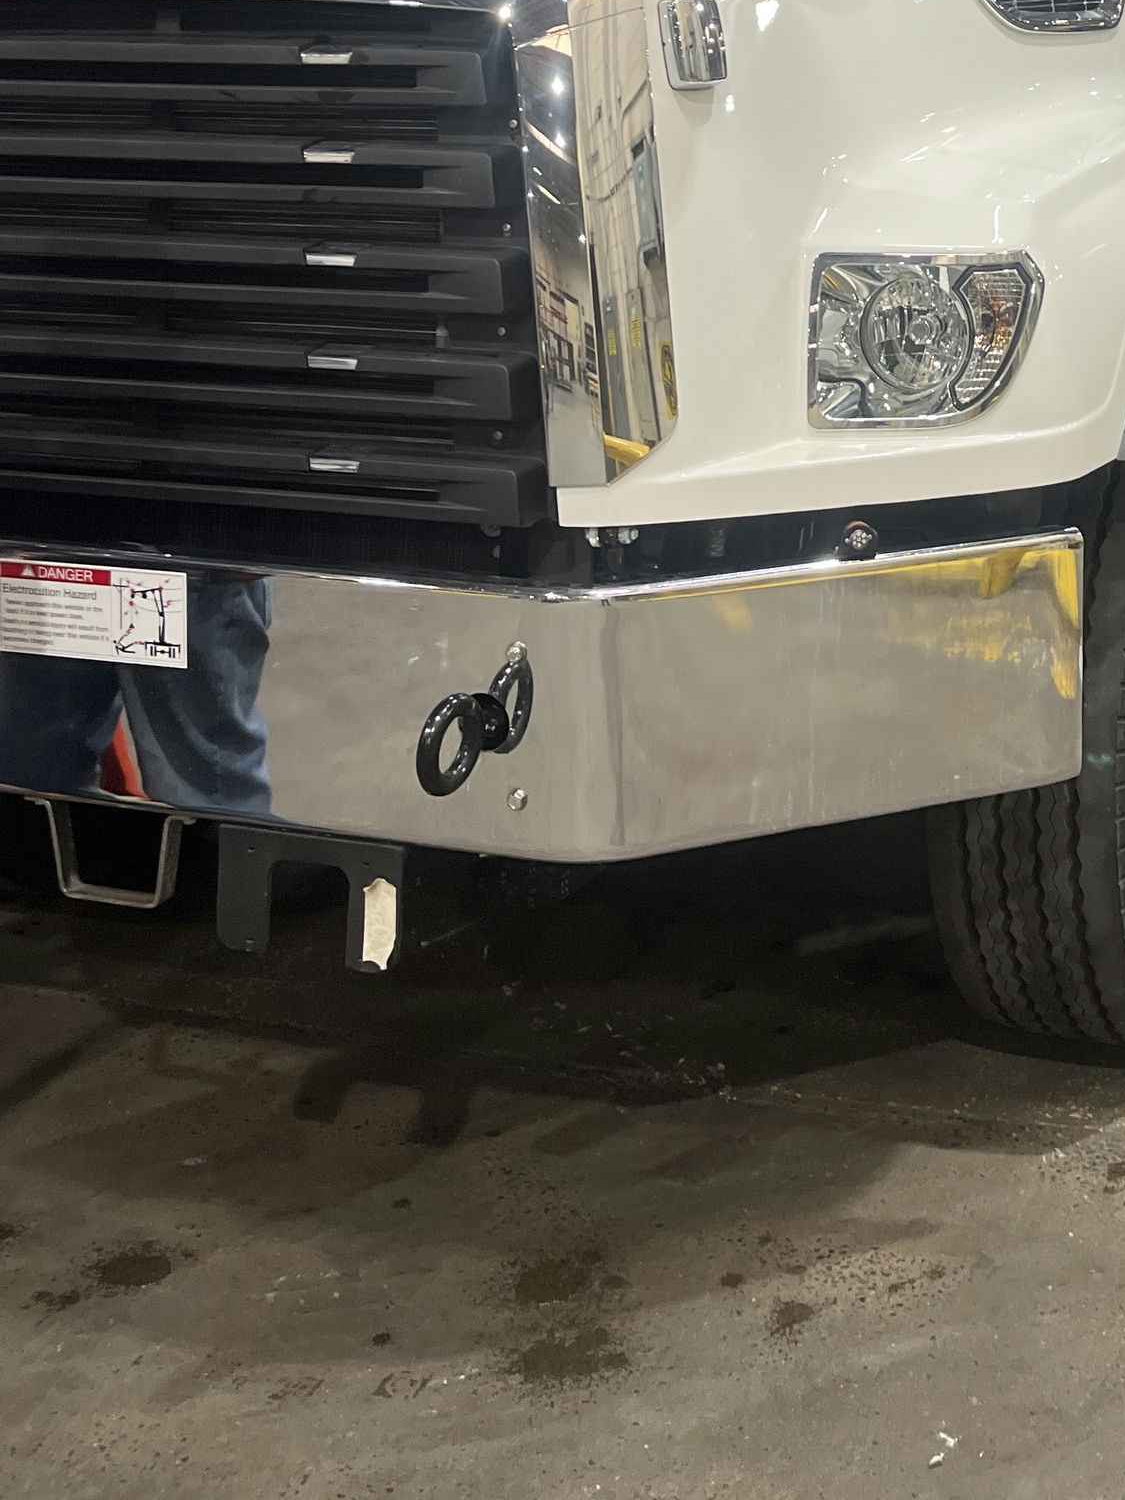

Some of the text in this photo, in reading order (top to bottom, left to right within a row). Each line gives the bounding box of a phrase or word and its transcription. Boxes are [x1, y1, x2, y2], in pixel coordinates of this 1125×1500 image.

[38, 566, 94, 582] DANGER
[2, 583, 97, 600] Electrocution Hazard
